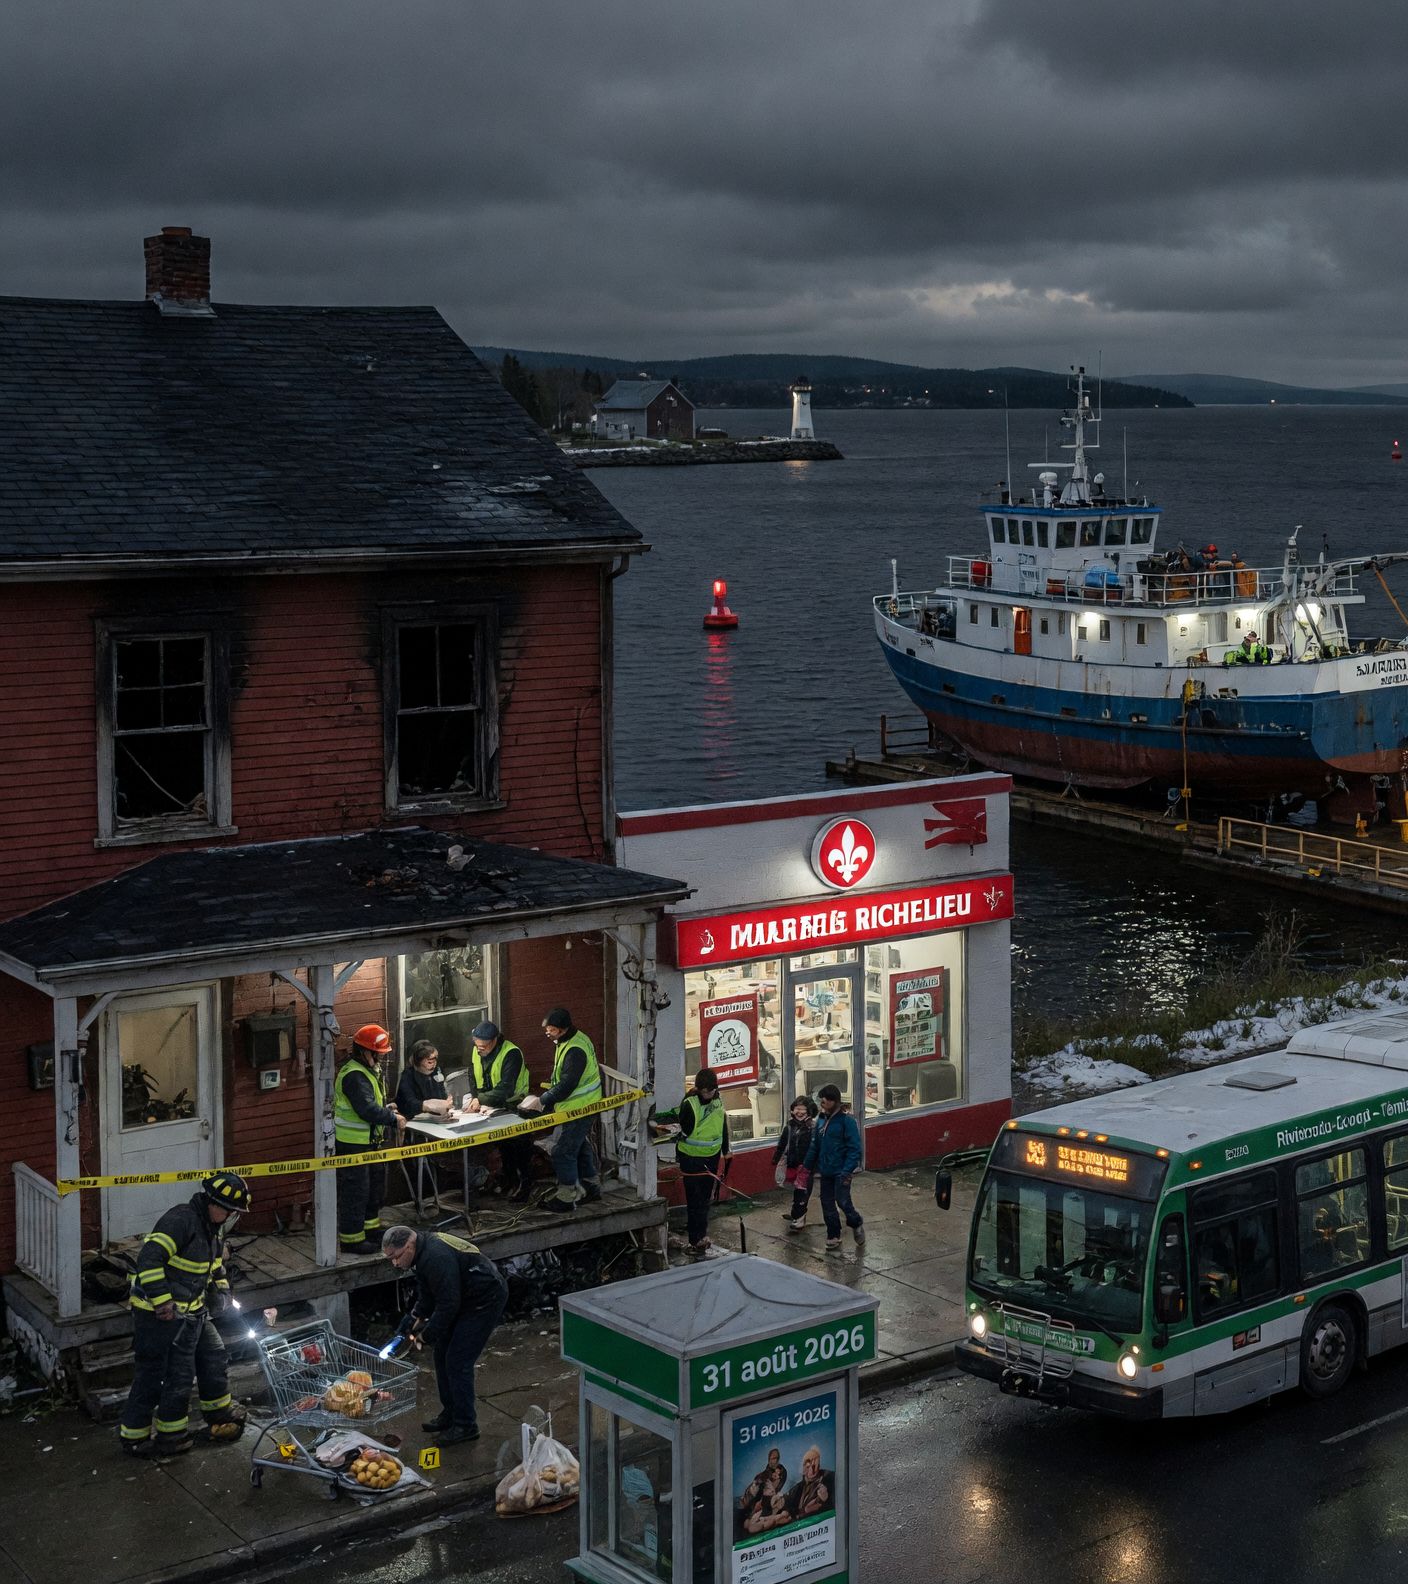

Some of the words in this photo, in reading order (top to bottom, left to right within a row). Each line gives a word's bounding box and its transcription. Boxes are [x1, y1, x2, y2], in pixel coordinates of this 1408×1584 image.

[855, 892, 972, 931] RICHELIEU
[702, 1360, 731, 1393] 31
[741, 1344, 798, 1382] août
[804, 1324, 865, 1366] 2026
[740, 1424, 757, 1444] 31
[794, 1404, 830, 1428] 2026
